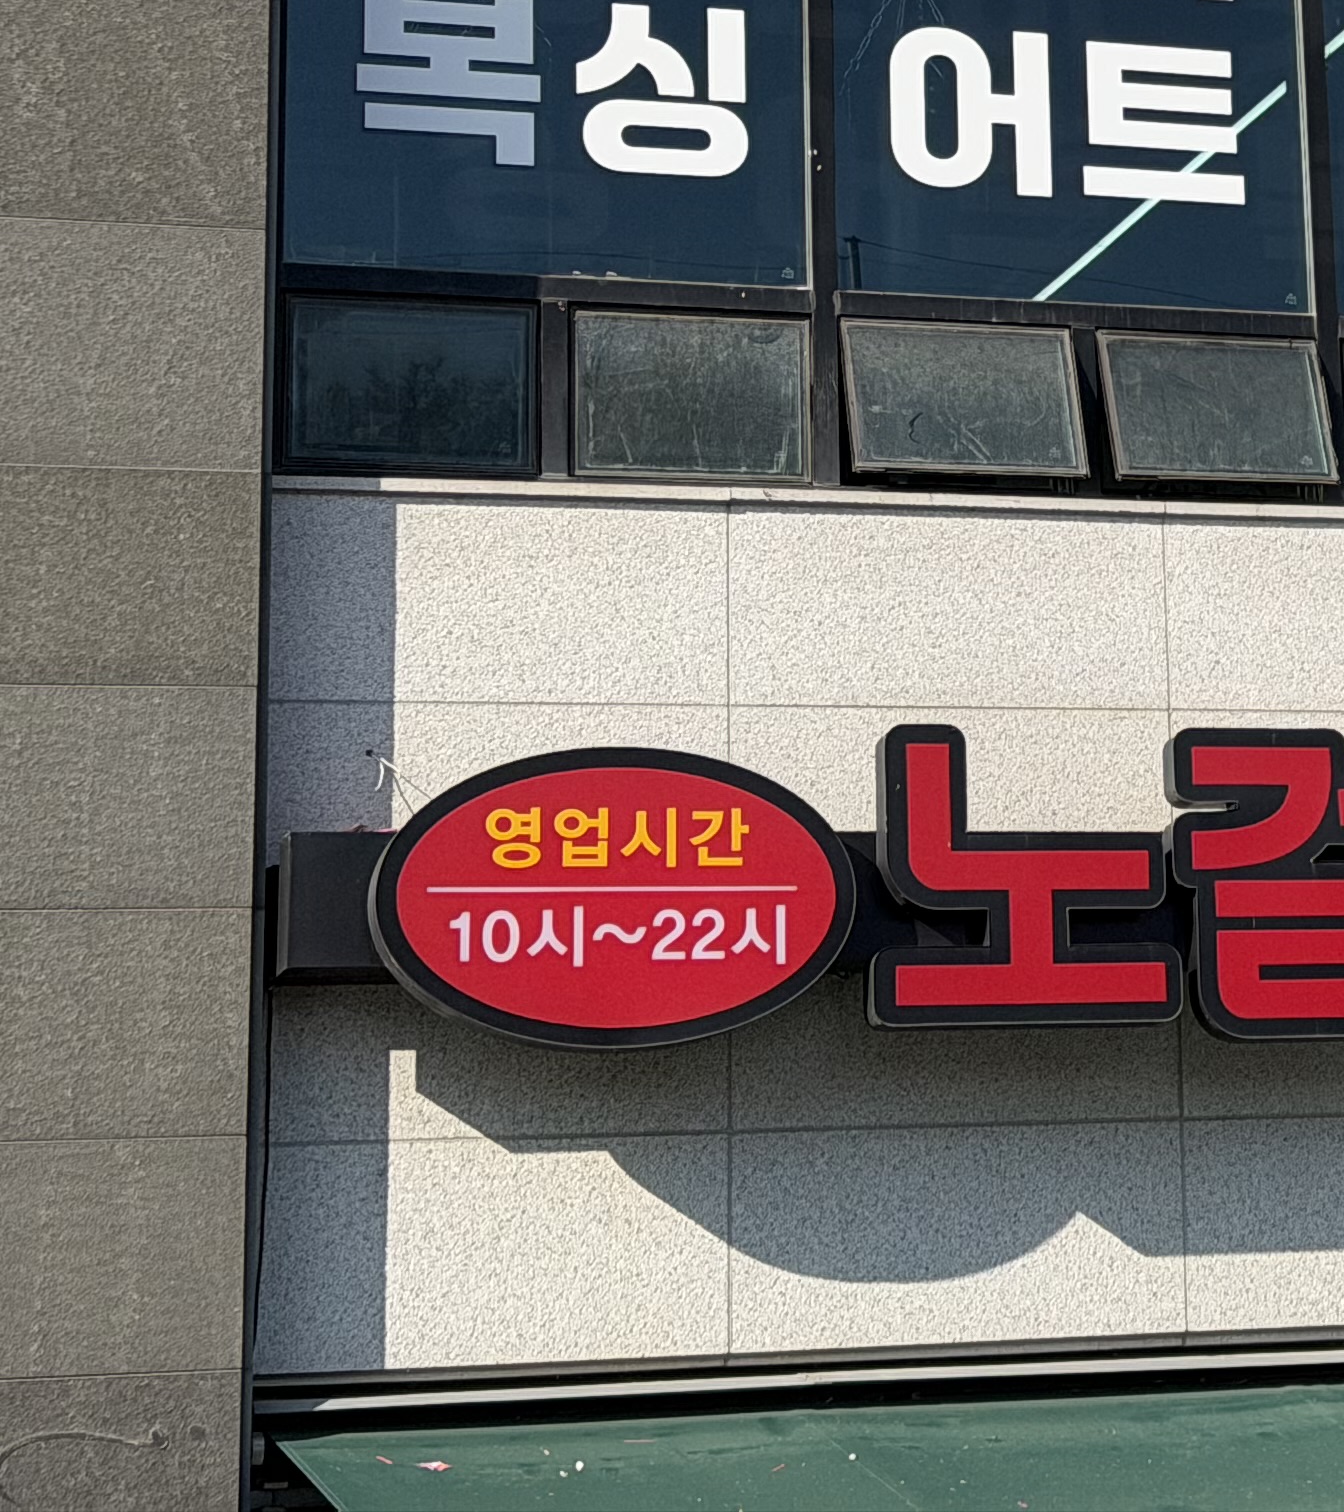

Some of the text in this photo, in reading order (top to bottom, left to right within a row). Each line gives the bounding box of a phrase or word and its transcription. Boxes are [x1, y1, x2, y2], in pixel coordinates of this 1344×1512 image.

[889, 25, 1246, 206] 어트
[485, 806, 750, 870] 영업시간
[448, 904, 787, 968] 10시~22시
